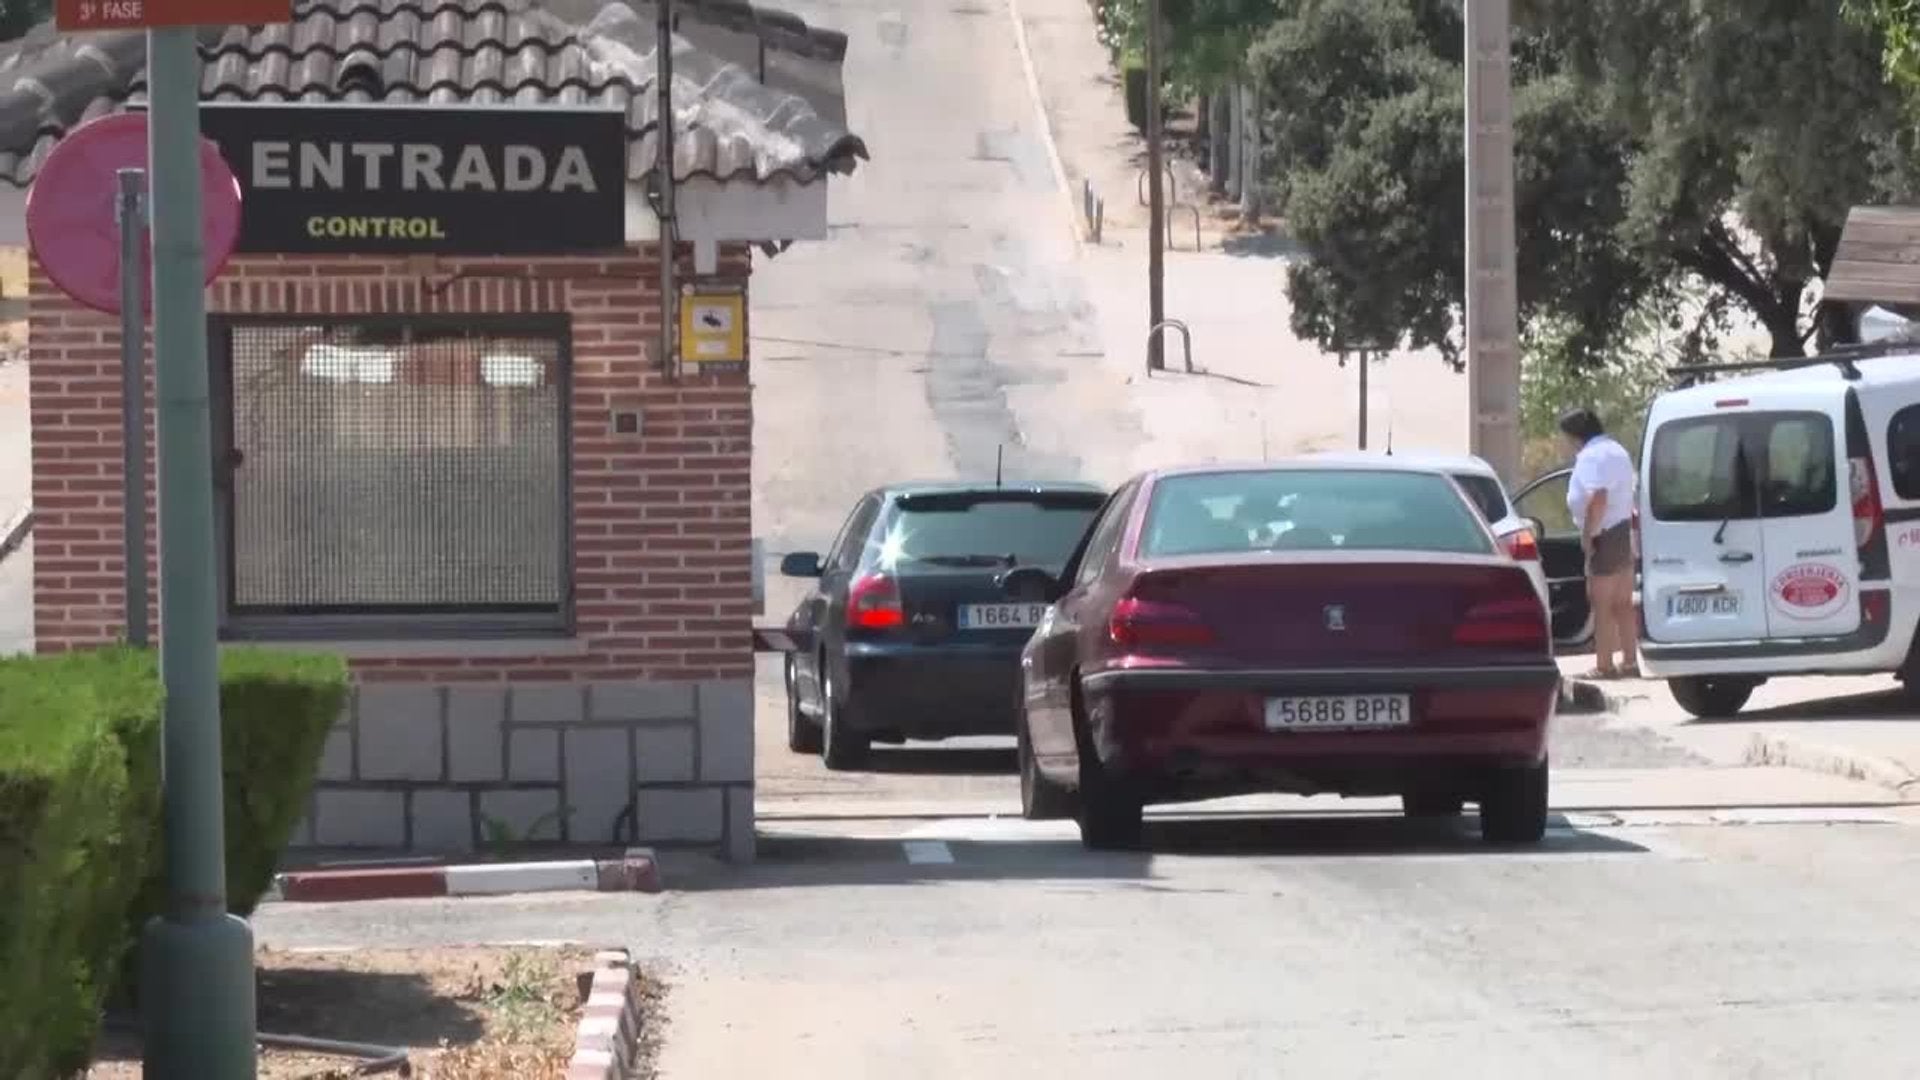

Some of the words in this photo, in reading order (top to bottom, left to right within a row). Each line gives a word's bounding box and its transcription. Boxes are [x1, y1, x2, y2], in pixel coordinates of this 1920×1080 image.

[102, 2, 142, 20] FASE
[251, 140, 598, 193] ENTRADA
[307, 216, 446, 239] CONTROL
[975, 606, 1022, 625] 1664
[1281, 700, 1346, 723] 5686
[1355, 698, 1403, 722] BPR
